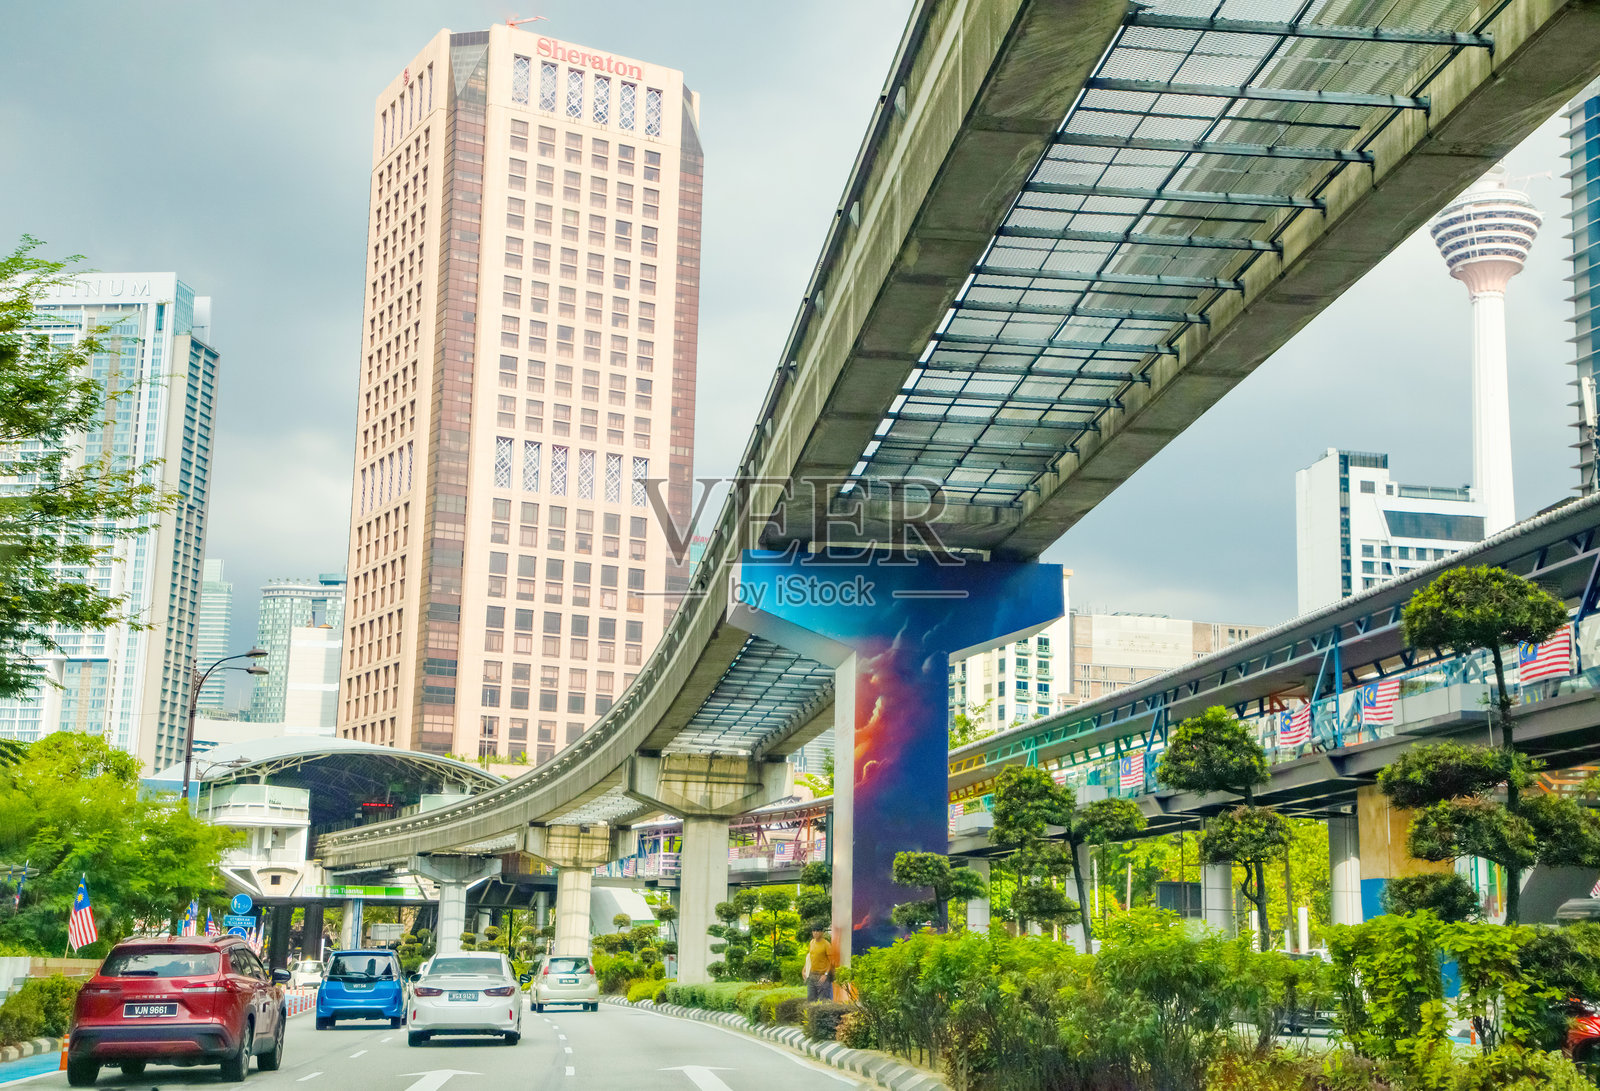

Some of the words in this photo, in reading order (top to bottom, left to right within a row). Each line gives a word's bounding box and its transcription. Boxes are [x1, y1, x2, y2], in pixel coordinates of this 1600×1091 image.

[536, 37, 643, 81] Sheraton
[134, 1006, 149, 1015] VJN
[149, 1006, 168, 1014] 9661
